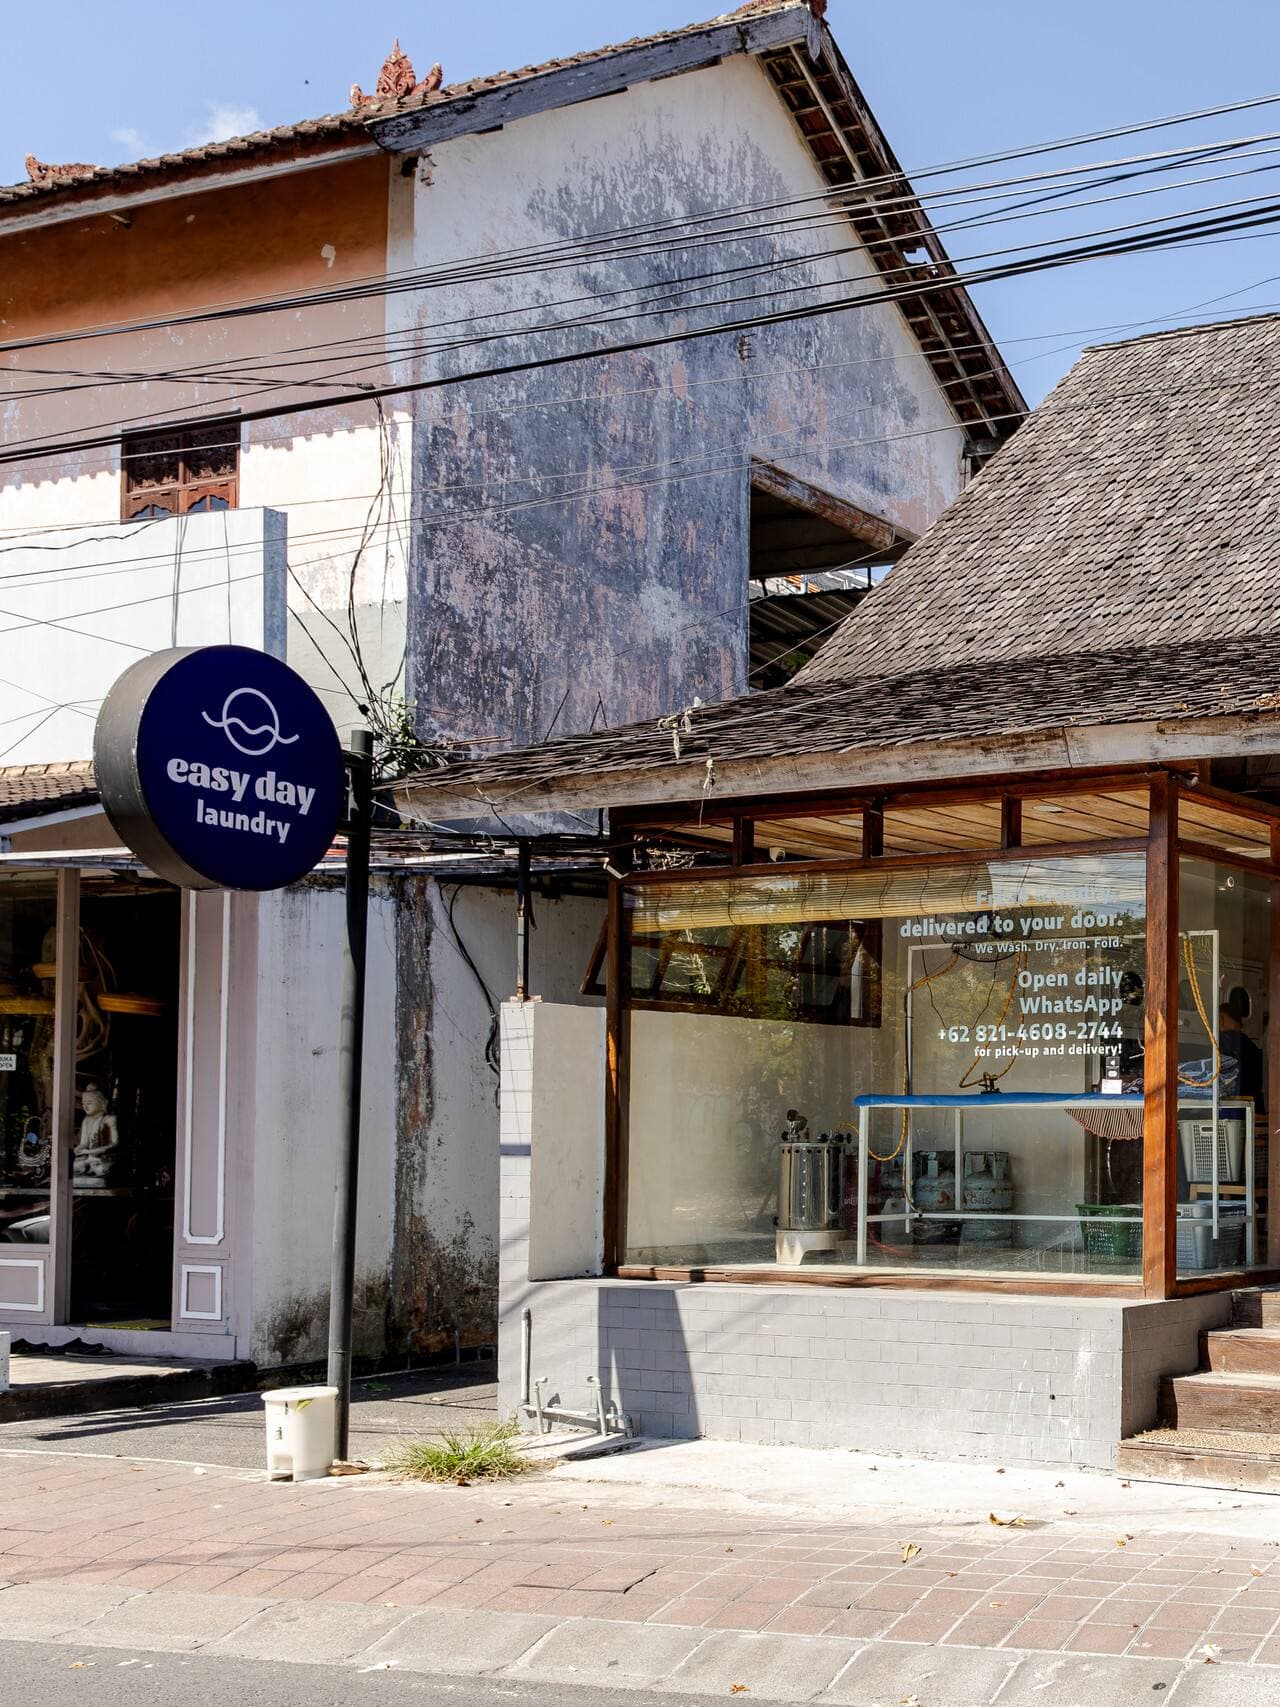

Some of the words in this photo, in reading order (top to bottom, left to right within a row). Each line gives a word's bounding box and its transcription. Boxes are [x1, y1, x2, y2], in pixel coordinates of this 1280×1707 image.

[167, 758, 250, 802] easy
[255, 771, 316, 815] day
[197, 799, 291, 843] laundry
[900, 915, 988, 937] delivered
[994, 917, 1014, 934] to
[1020, 915, 1065, 936] your
[1070, 910, 1123, 929] door.
[975, 943, 993, 954] We
[997, 942, 1031, 953] Wash.
[1035, 941, 1059, 953] Dry.
[1063, 940, 1090, 950] Iron.
[1094, 937, 1124, 949] Fold.
[1018, 970, 1069, 992] Open
[1075, 966, 1124, 989] daily
[1019, 995, 1124, 1016] WhatsApp
[938, 1024, 970, 1043] +62
[975, 1021, 1124, 1042] 821-4608-2744
[974, 1046, 991, 1057] for
[995, 1045, 1040, 1059] pick-up
[1043, 1044, 1065, 1056] and
[1068, 1043, 1122, 1057] delivery!
